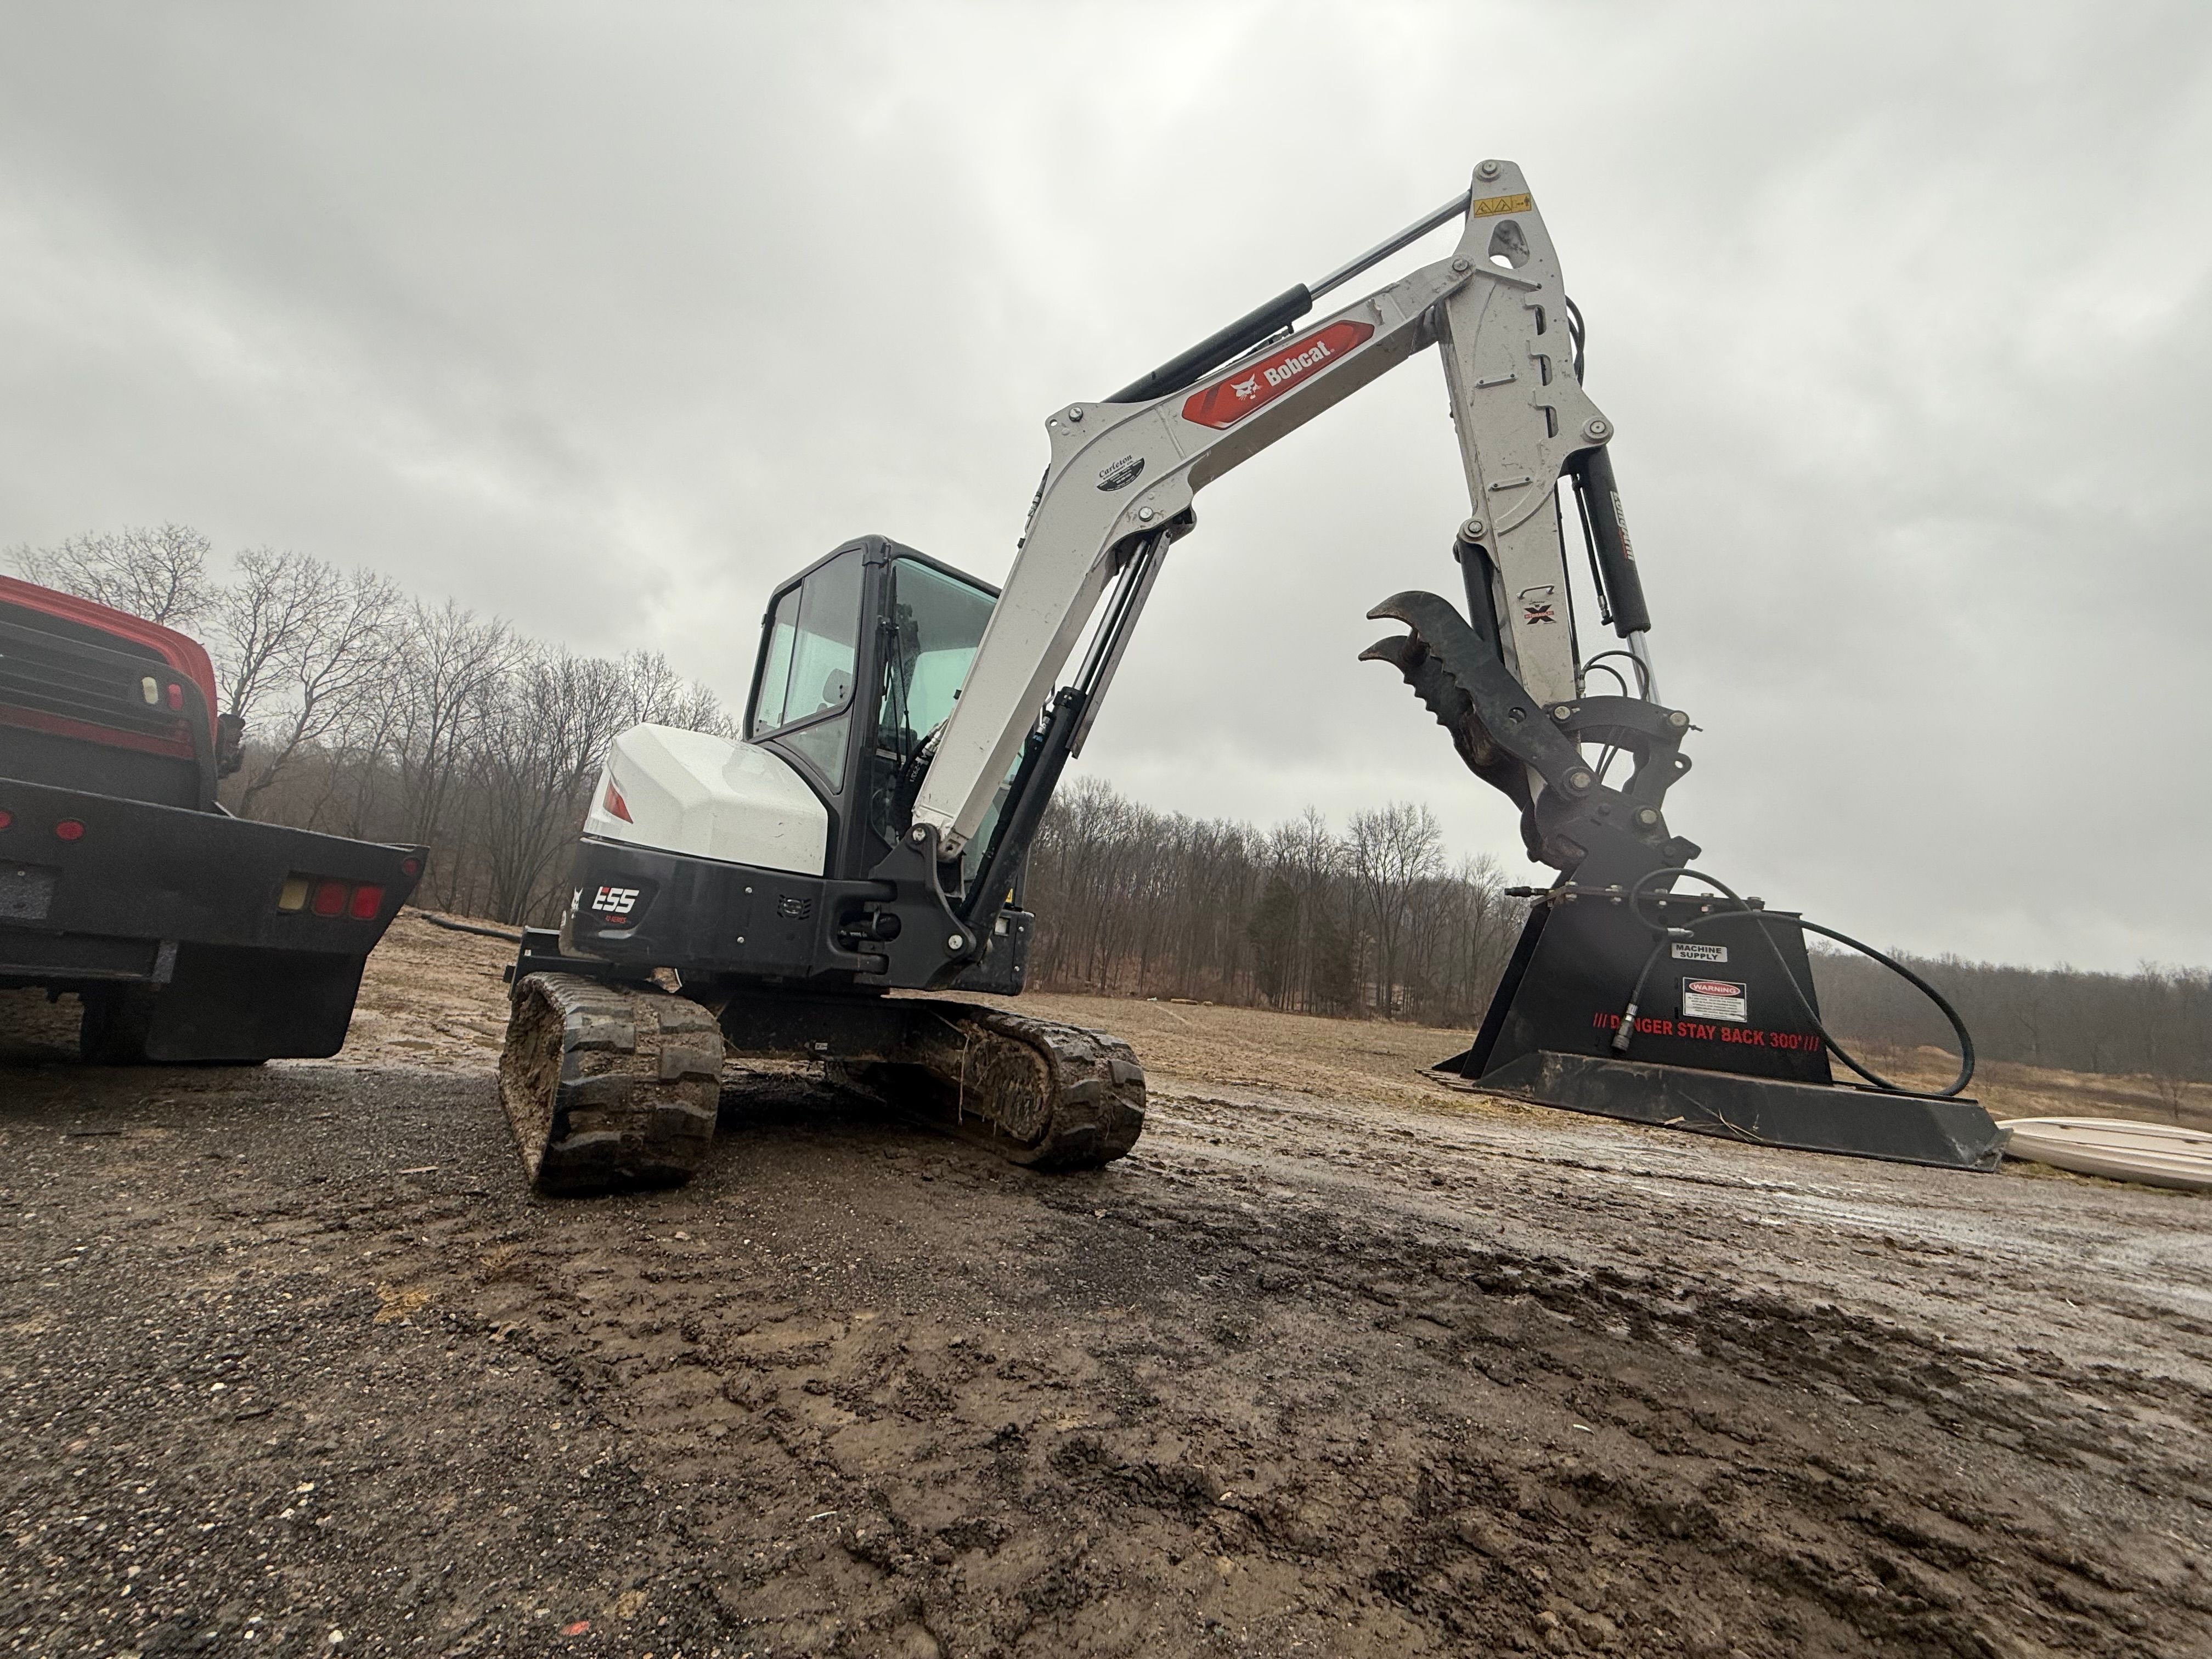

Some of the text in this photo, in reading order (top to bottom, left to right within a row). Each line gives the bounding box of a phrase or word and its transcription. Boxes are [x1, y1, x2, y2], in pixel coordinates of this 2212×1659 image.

[1263, 341, 1331, 387] Bobcat
[1099, 455, 1132, 477] Carleton
[592, 887, 640, 913] E55
[1676, 944, 1722, 953] MACHINE
[1680, 951, 1718, 960] SUPPLY
[1694, 984, 1736, 994] WARNING
[1610, 1015, 1673, 1035] DNGER
[1677, 1021, 1717, 1040] STAY
[1720, 1027, 1765, 1046] BACK
